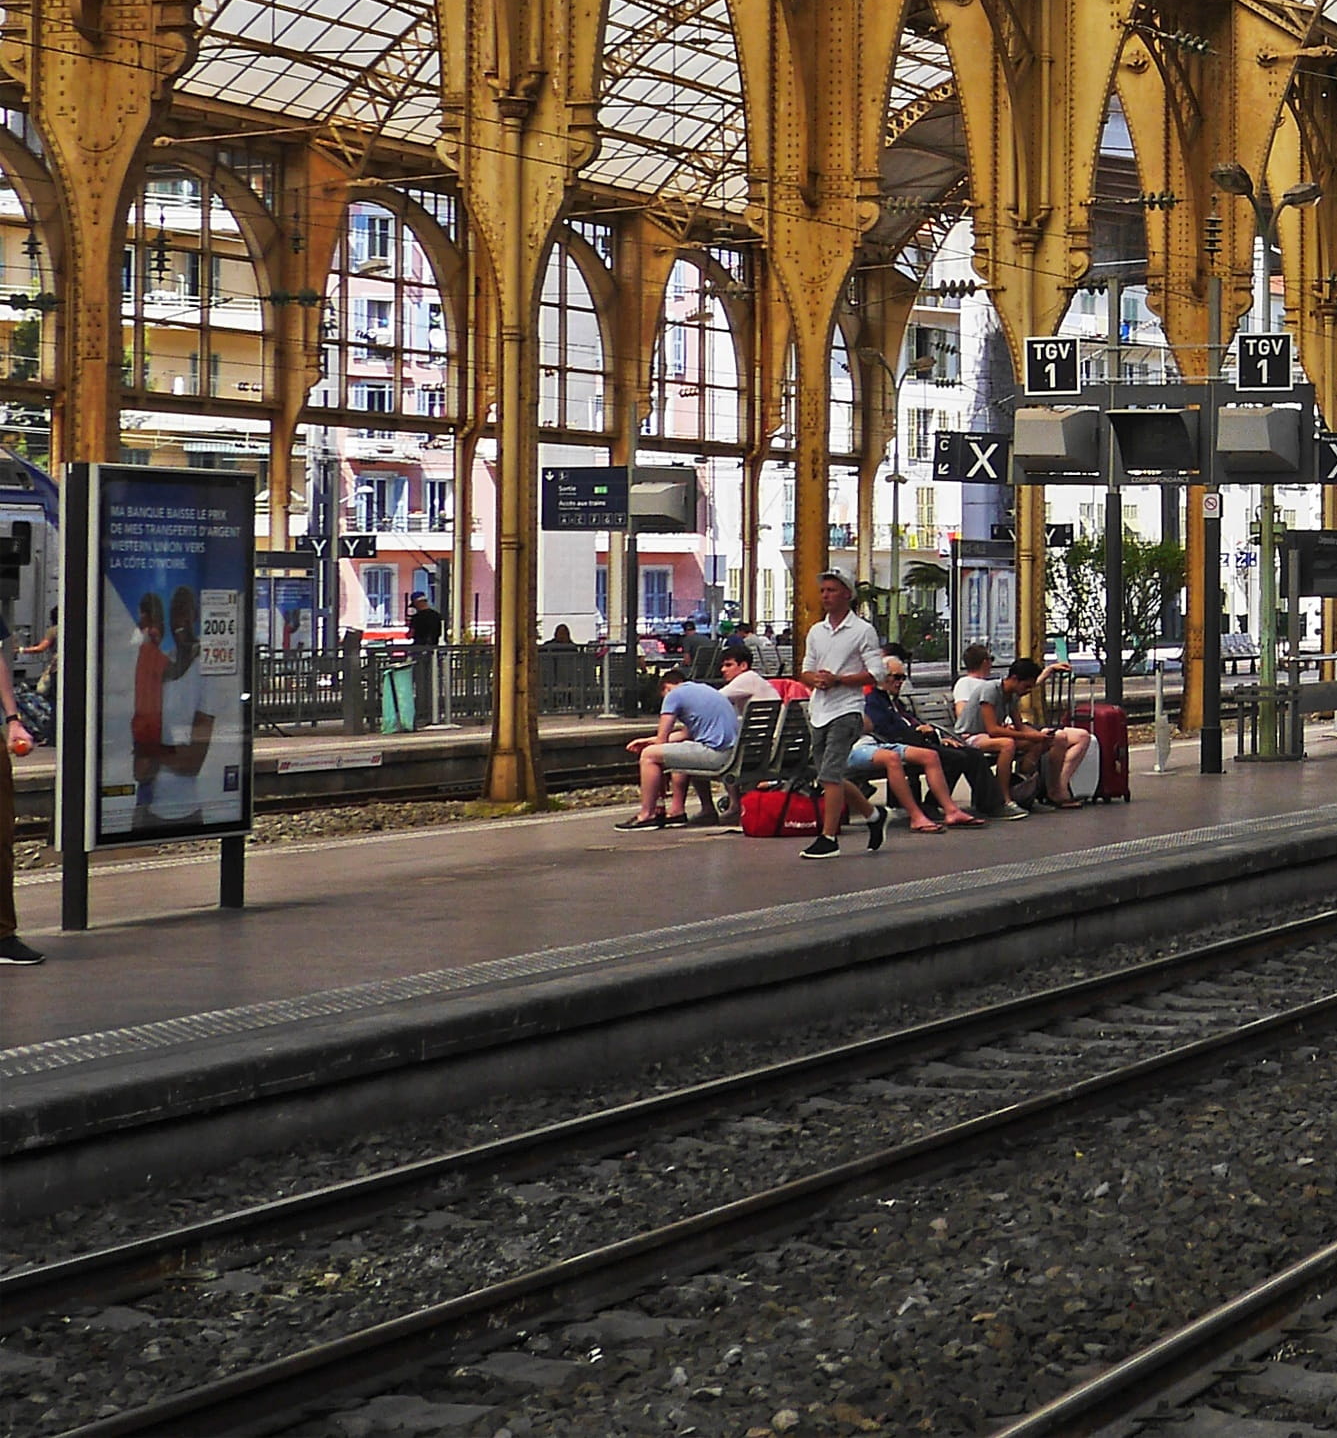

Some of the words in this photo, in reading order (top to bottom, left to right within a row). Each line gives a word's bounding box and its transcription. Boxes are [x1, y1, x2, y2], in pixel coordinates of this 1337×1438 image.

[1033, 343, 1070, 360] TGV
[1246, 339, 1283, 356] TGV
[1044, 363, 1056, 388] 1
[1257, 359, 1268, 384] 1
[940, 440, 949, 451] C
[966, 442, 999, 478] X
[110, 506, 125, 517] MA
[127, 506, 164, 518] BANQUE
[166, 508, 195, 519] BAISSE
[197, 509, 207, 520] LE
[110, 523, 122, 534] DE
[124, 524, 143, 535] MES
[145, 524, 197, 536] TRANSFERTS
[312, 539, 327, 557] Y
[344, 539, 360, 556] Y
[110, 558, 121, 568] LA
[204, 620, 225, 635] 200
[228, 619, 234, 635] €
[203, 648, 225, 665] 7,90
